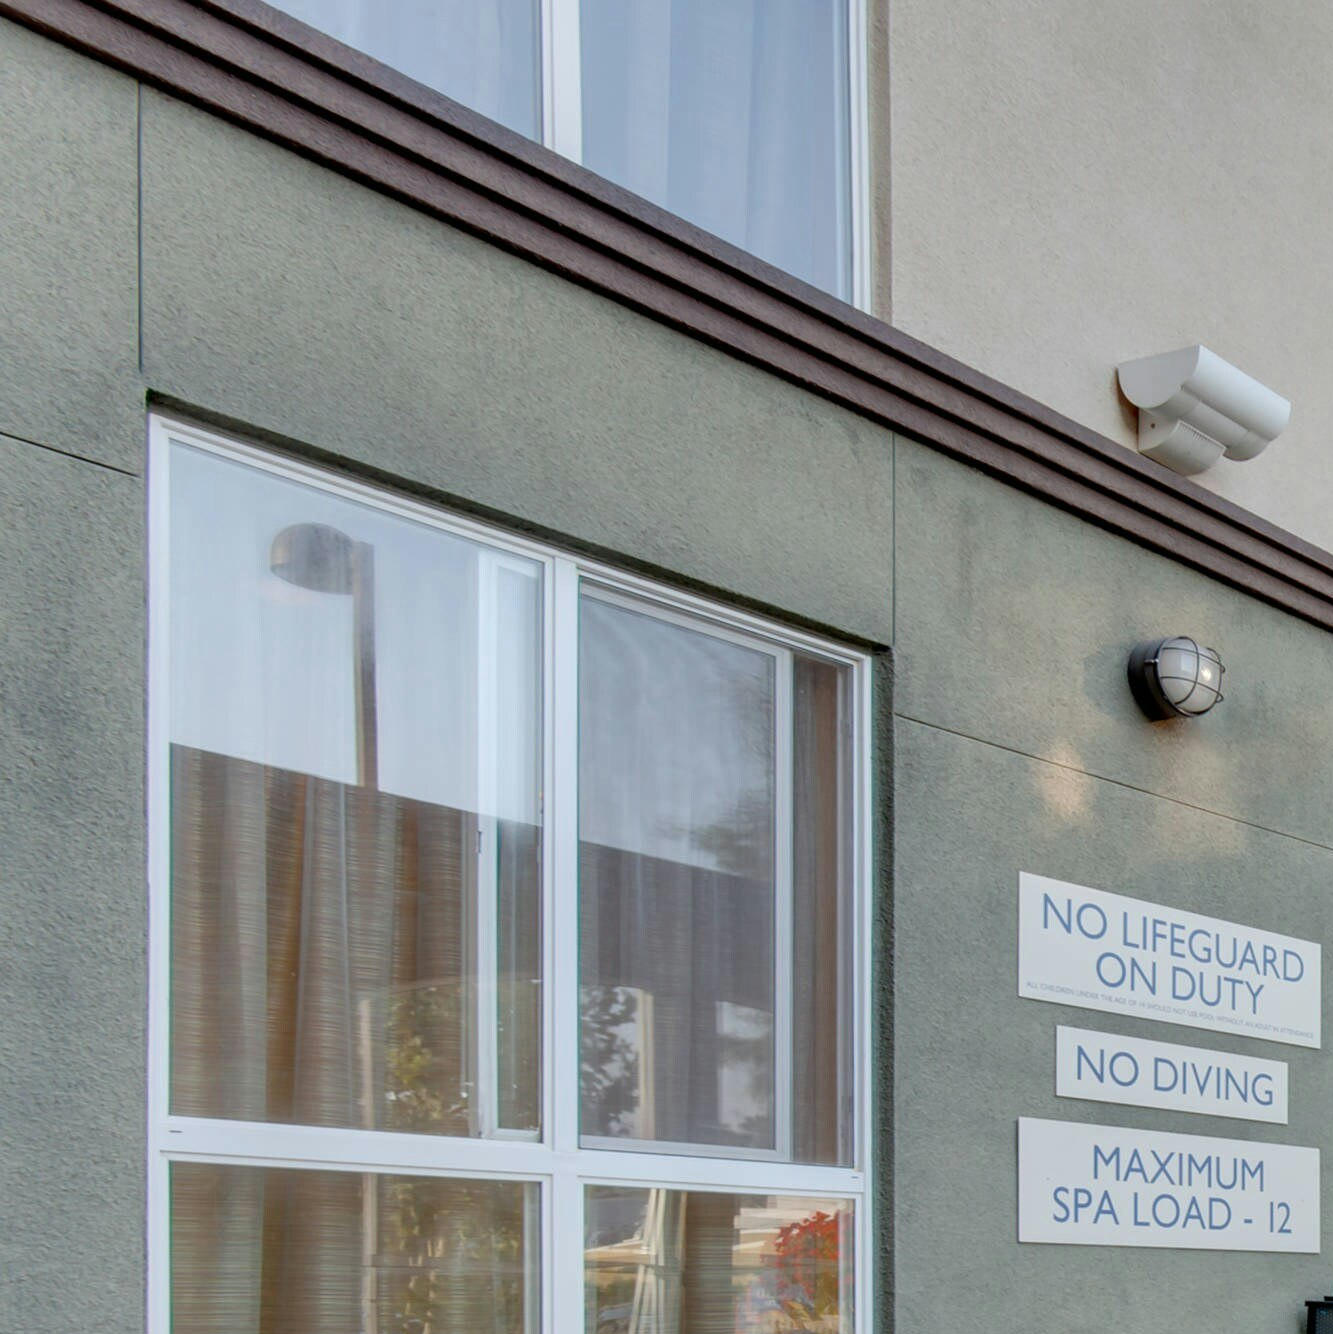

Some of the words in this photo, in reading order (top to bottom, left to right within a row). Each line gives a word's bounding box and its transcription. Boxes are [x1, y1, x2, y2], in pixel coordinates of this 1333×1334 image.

[1042, 893, 1108, 940] NO
[1122, 911, 1305, 983] LIFEGUARD
[1096, 952, 1158, 997] ON
[1171, 966, 1265, 1015] DUTY
[1077, 1045, 1139, 1087] NO
[1153, 1057, 1273, 1107] DIVING
[1093, 1144, 1264, 1193] MAXIMUM
[1052, 1186, 1120, 1225] SPA
[1133, 1191, 1232, 1230] LOAD
[1269, 1201, 1293, 1234] 12
